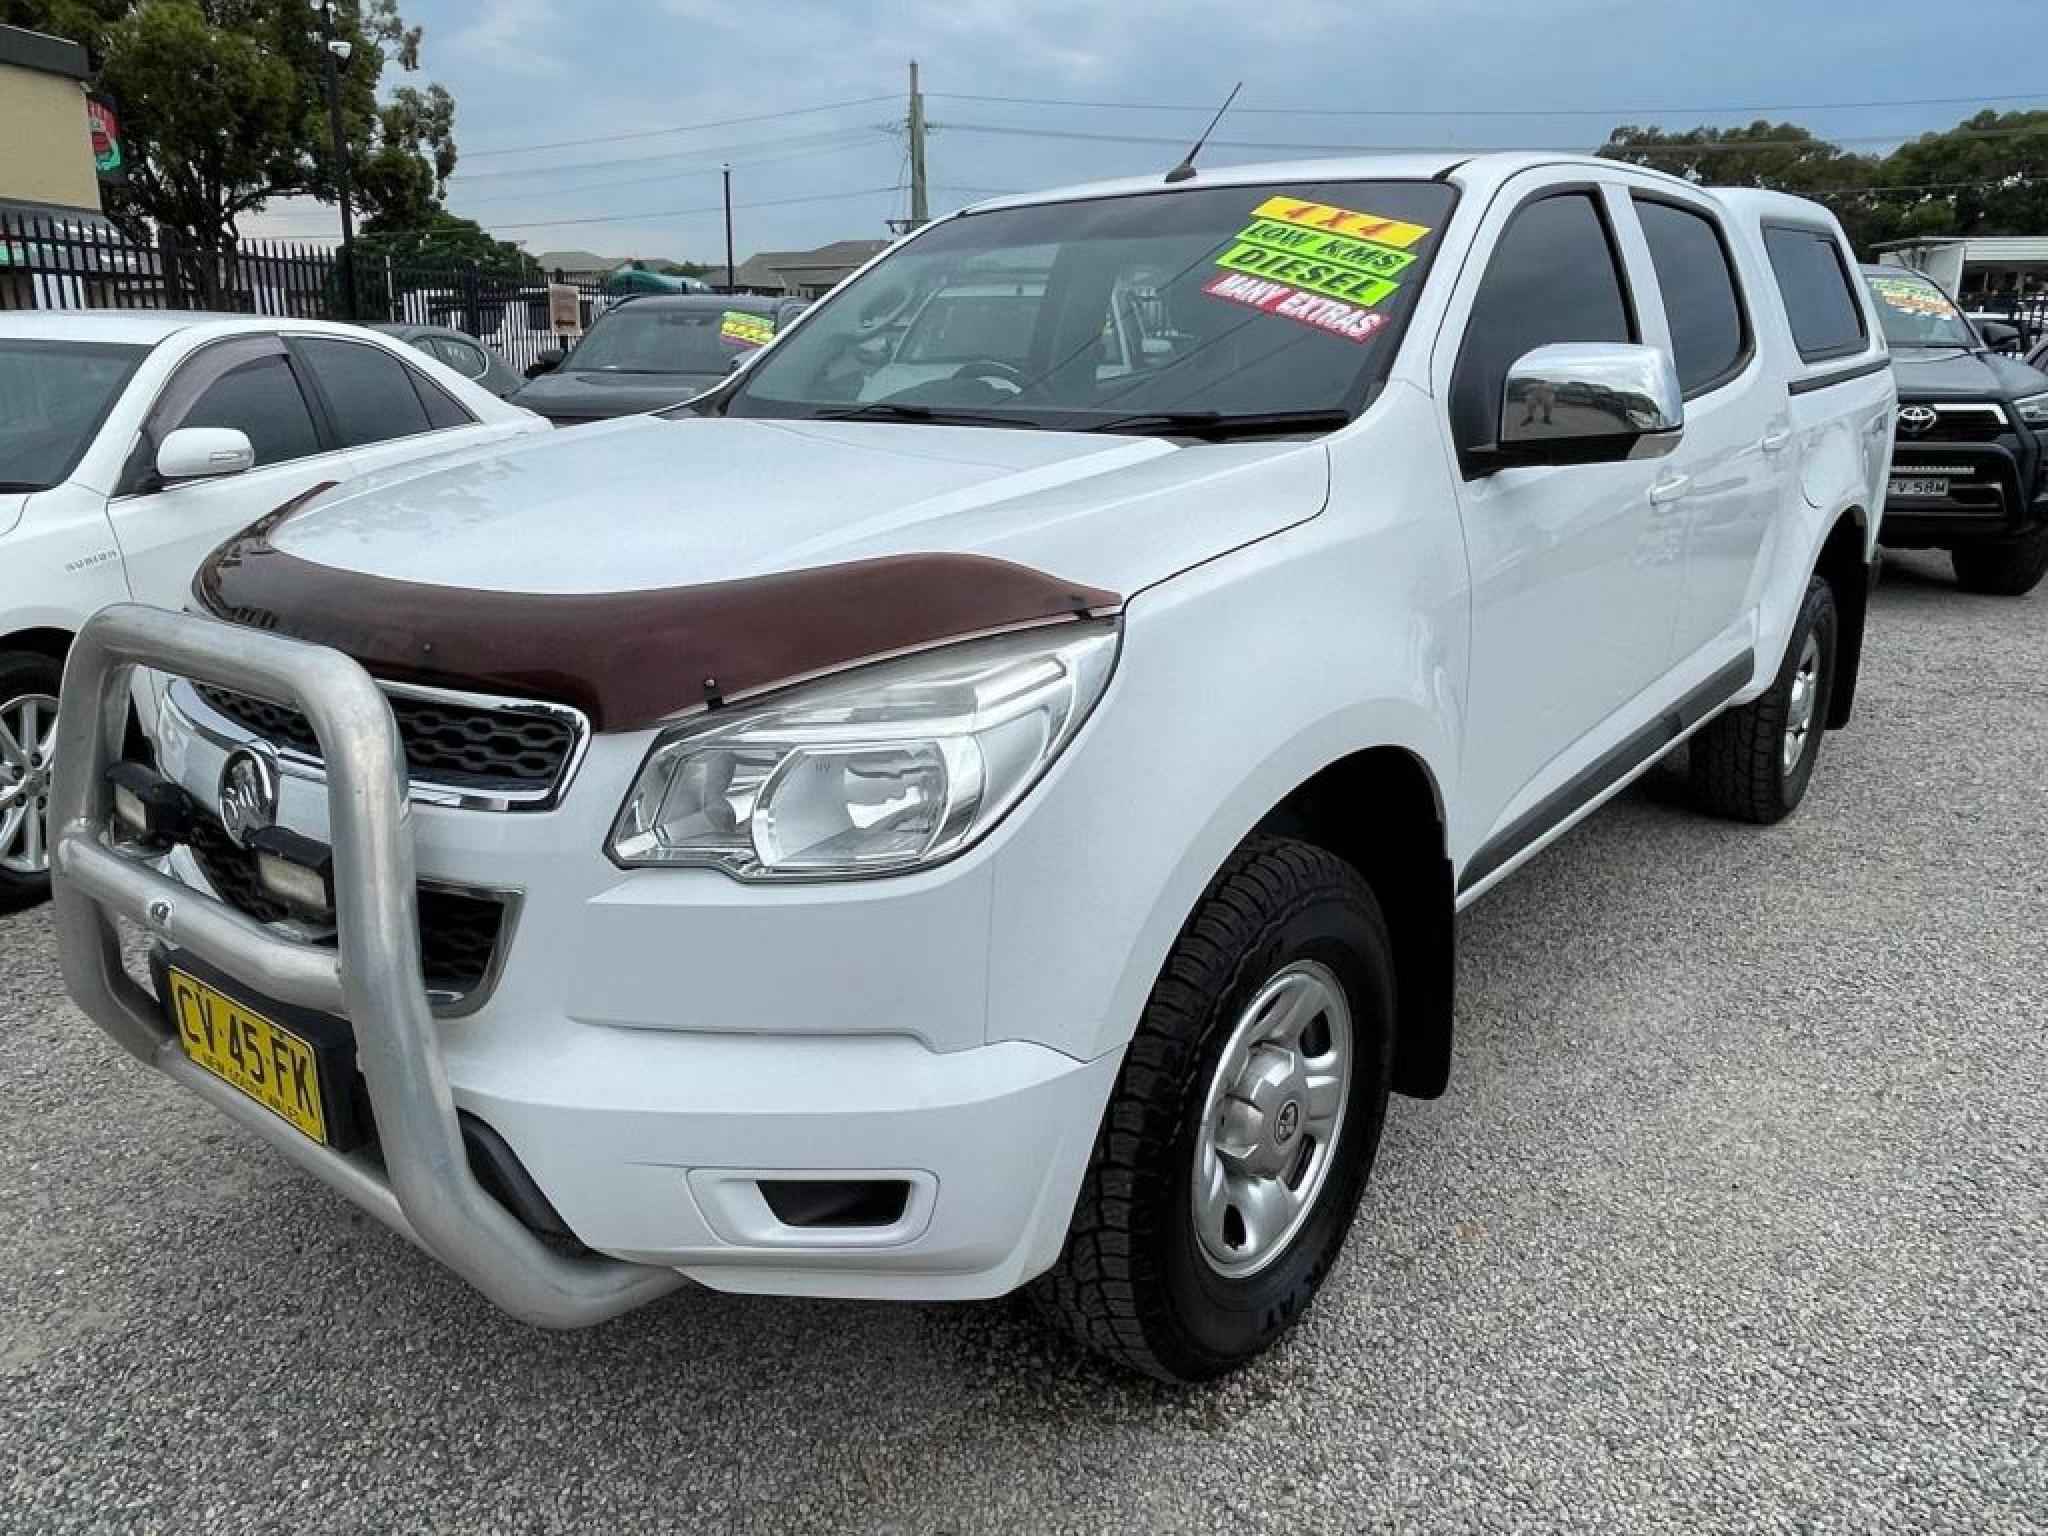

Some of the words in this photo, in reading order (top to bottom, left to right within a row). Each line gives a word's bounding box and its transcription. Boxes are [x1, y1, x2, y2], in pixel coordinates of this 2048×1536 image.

[1244, 222, 1322, 249] LOW
[1313, 239, 1407, 269] KMS
[1229, 249, 1379, 299] DIESEL
[1211, 273, 1293, 306] MANY
[1275, 291, 1382, 338] EXTRAS
